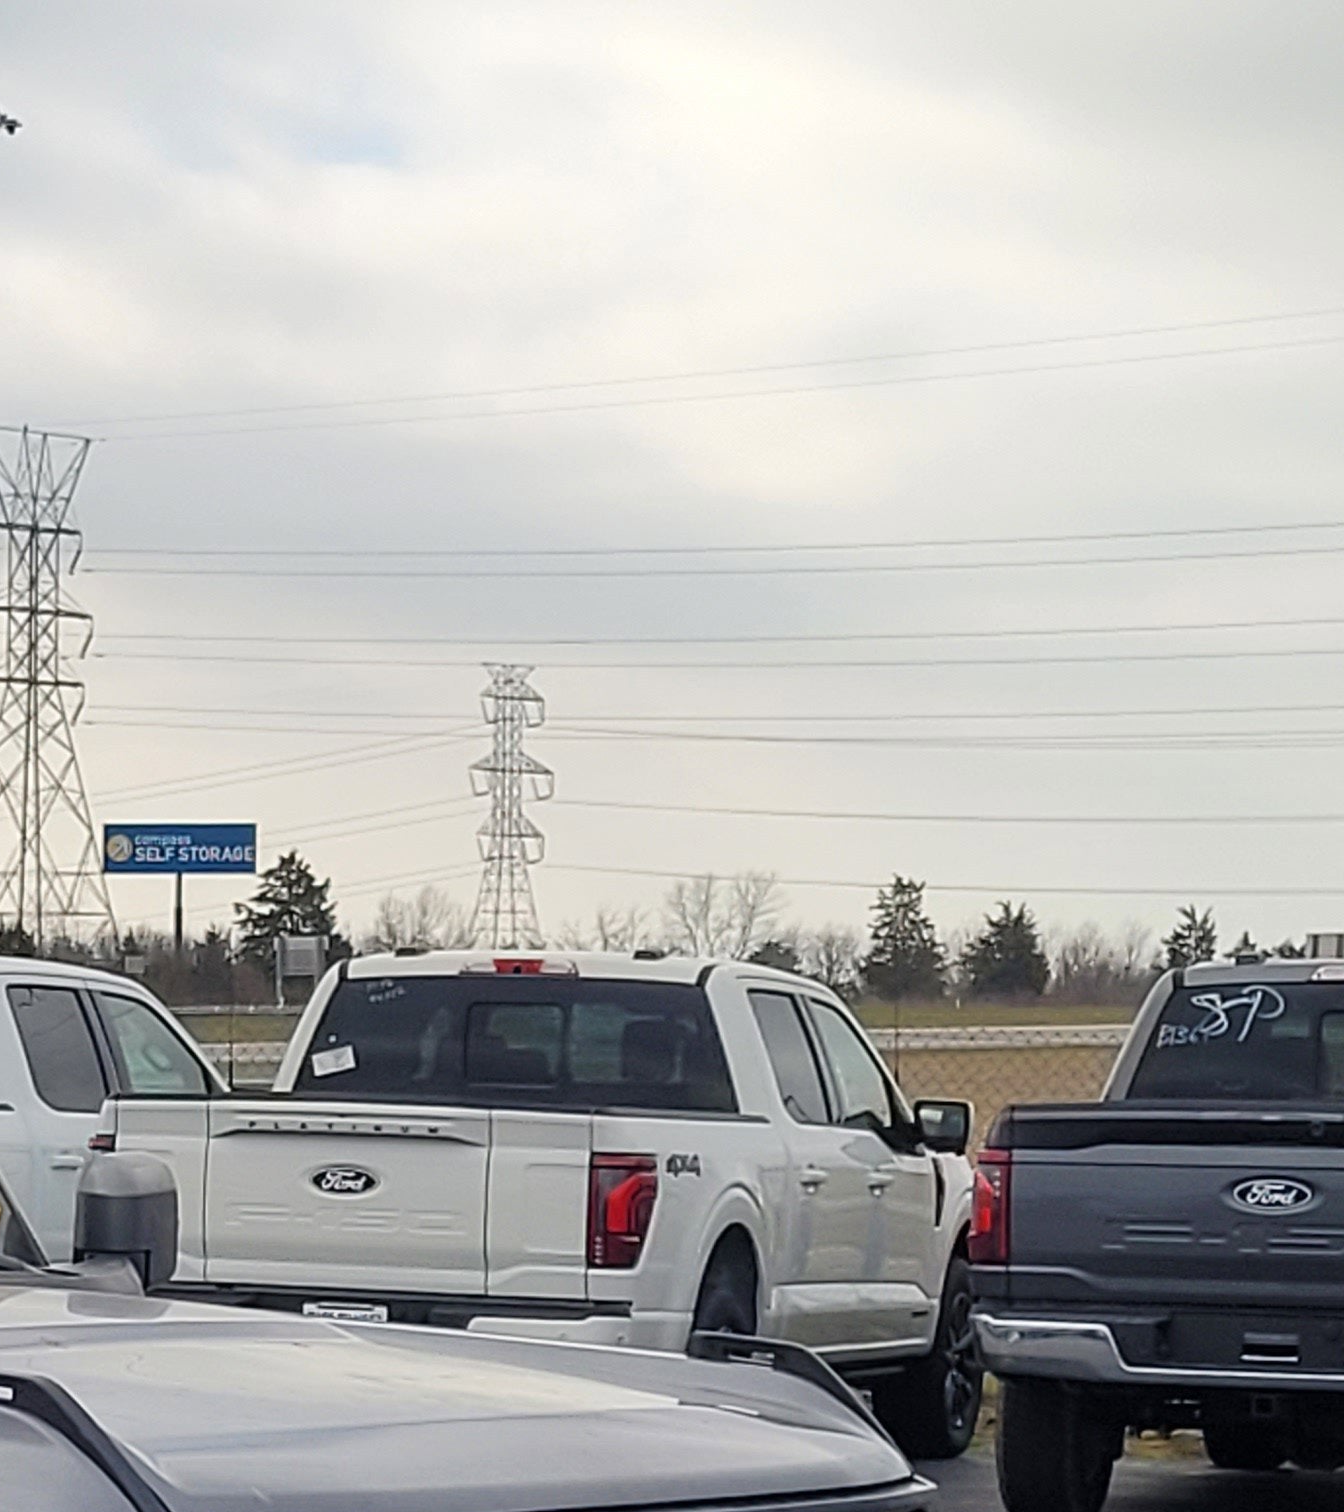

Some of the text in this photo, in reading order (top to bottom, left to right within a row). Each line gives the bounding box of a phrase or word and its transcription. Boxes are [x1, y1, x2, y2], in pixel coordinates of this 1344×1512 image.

[134, 845, 256, 863] SELF STORAGE
[317, 1168, 370, 1192] Ford
[1241, 1182, 1302, 1206] Ford
